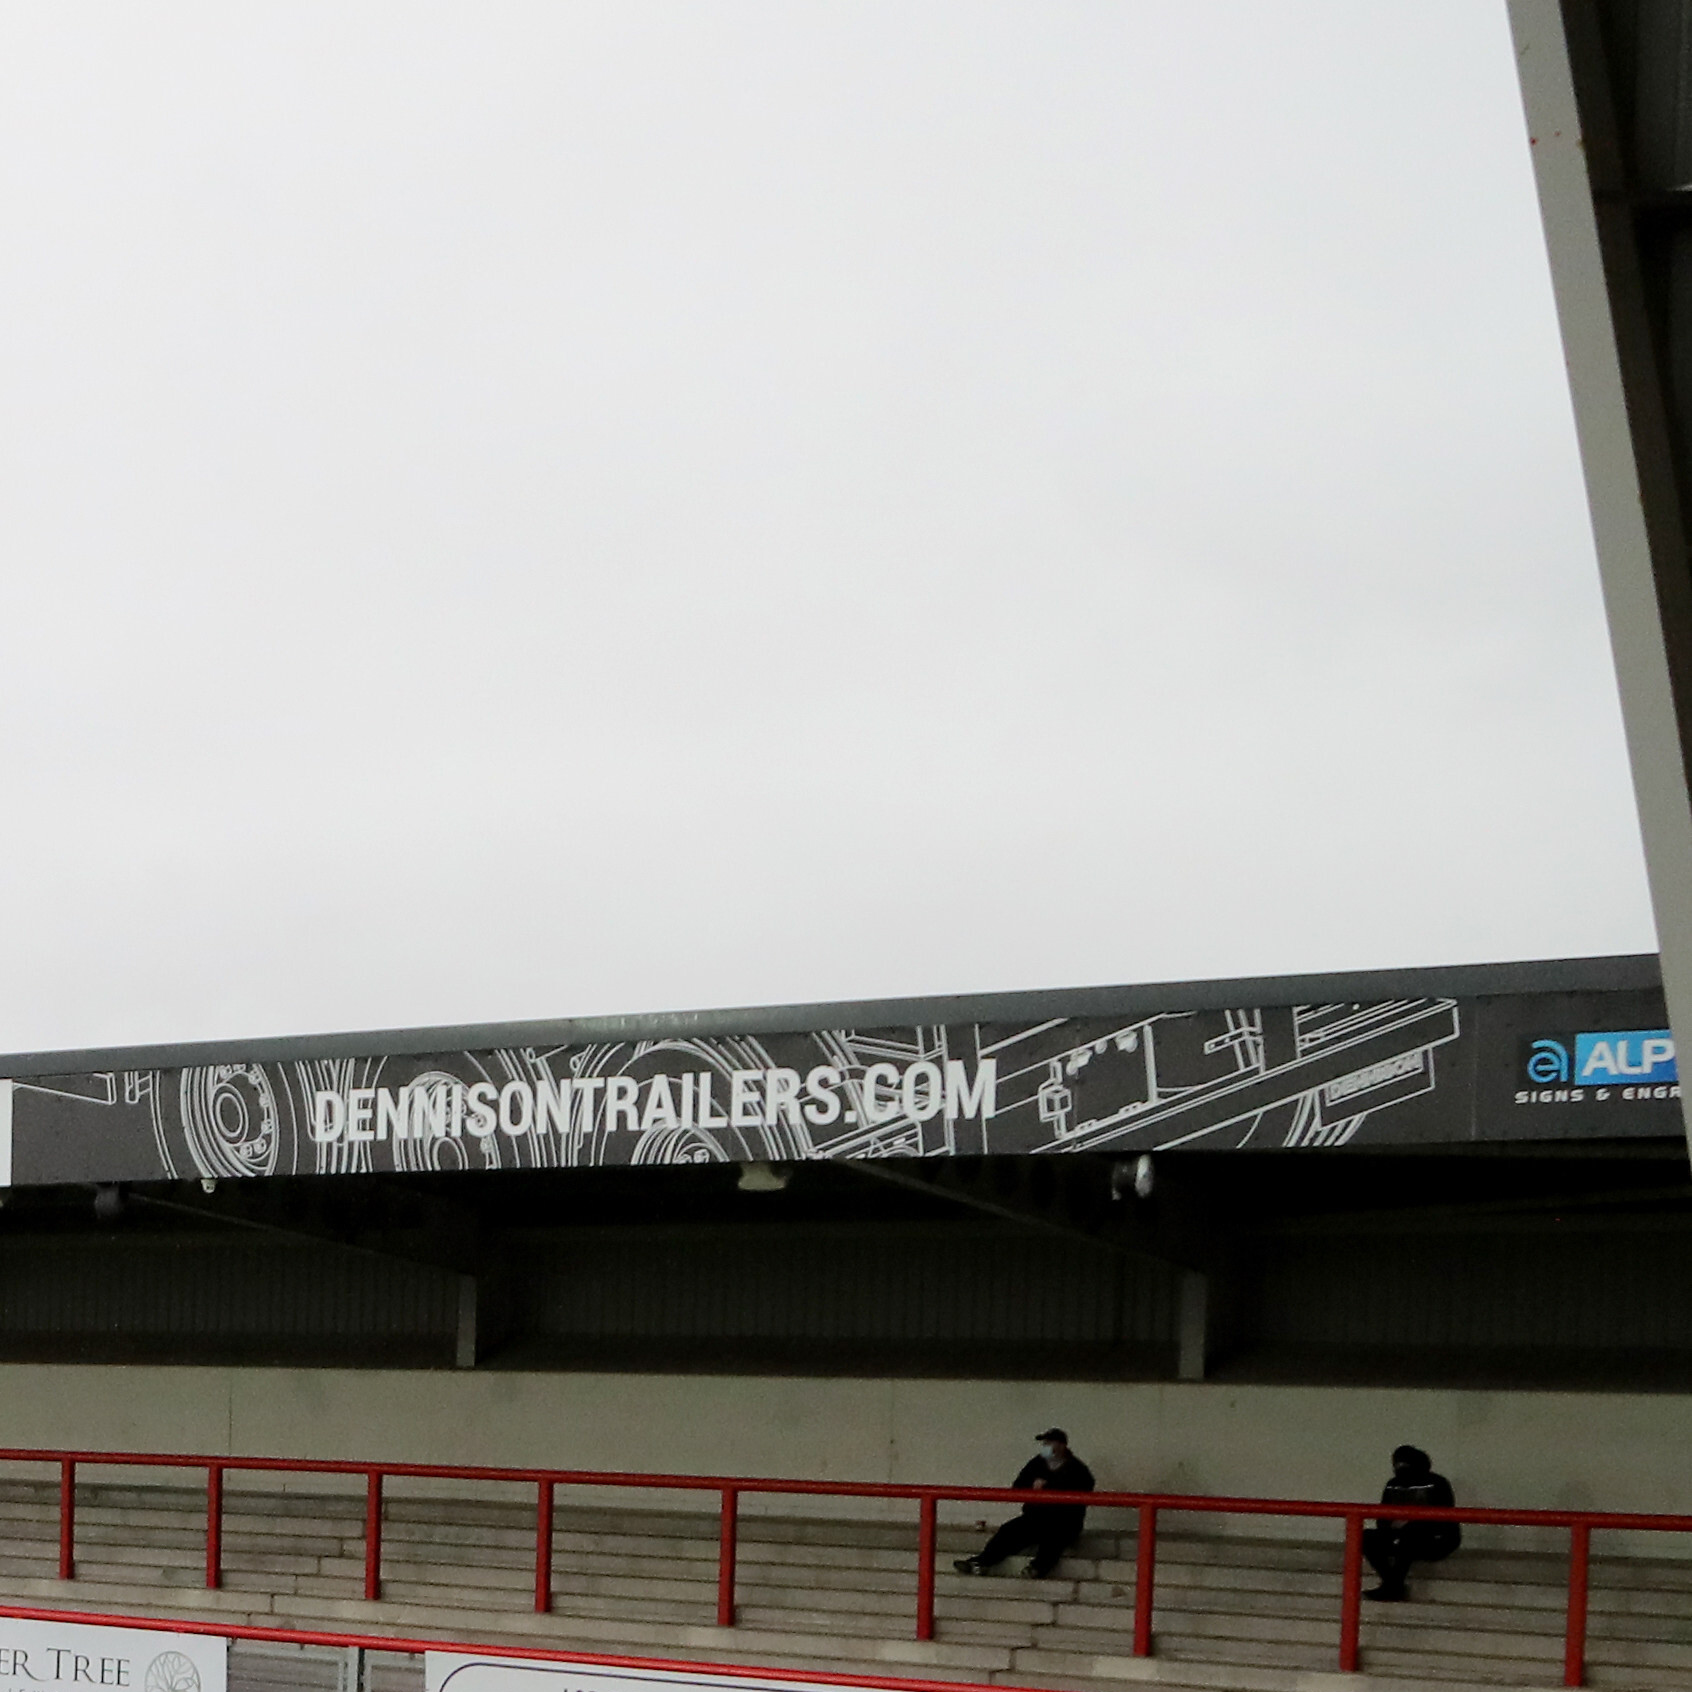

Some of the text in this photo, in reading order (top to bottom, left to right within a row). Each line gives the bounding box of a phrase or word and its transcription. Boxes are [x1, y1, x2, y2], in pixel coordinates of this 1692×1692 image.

[313, 1059, 997, 1143] DENNISONTRAILERS.COM
[1515, 1088, 1611, 1104] SIGNS &
[47, 1648, 131, 1687] TREE
